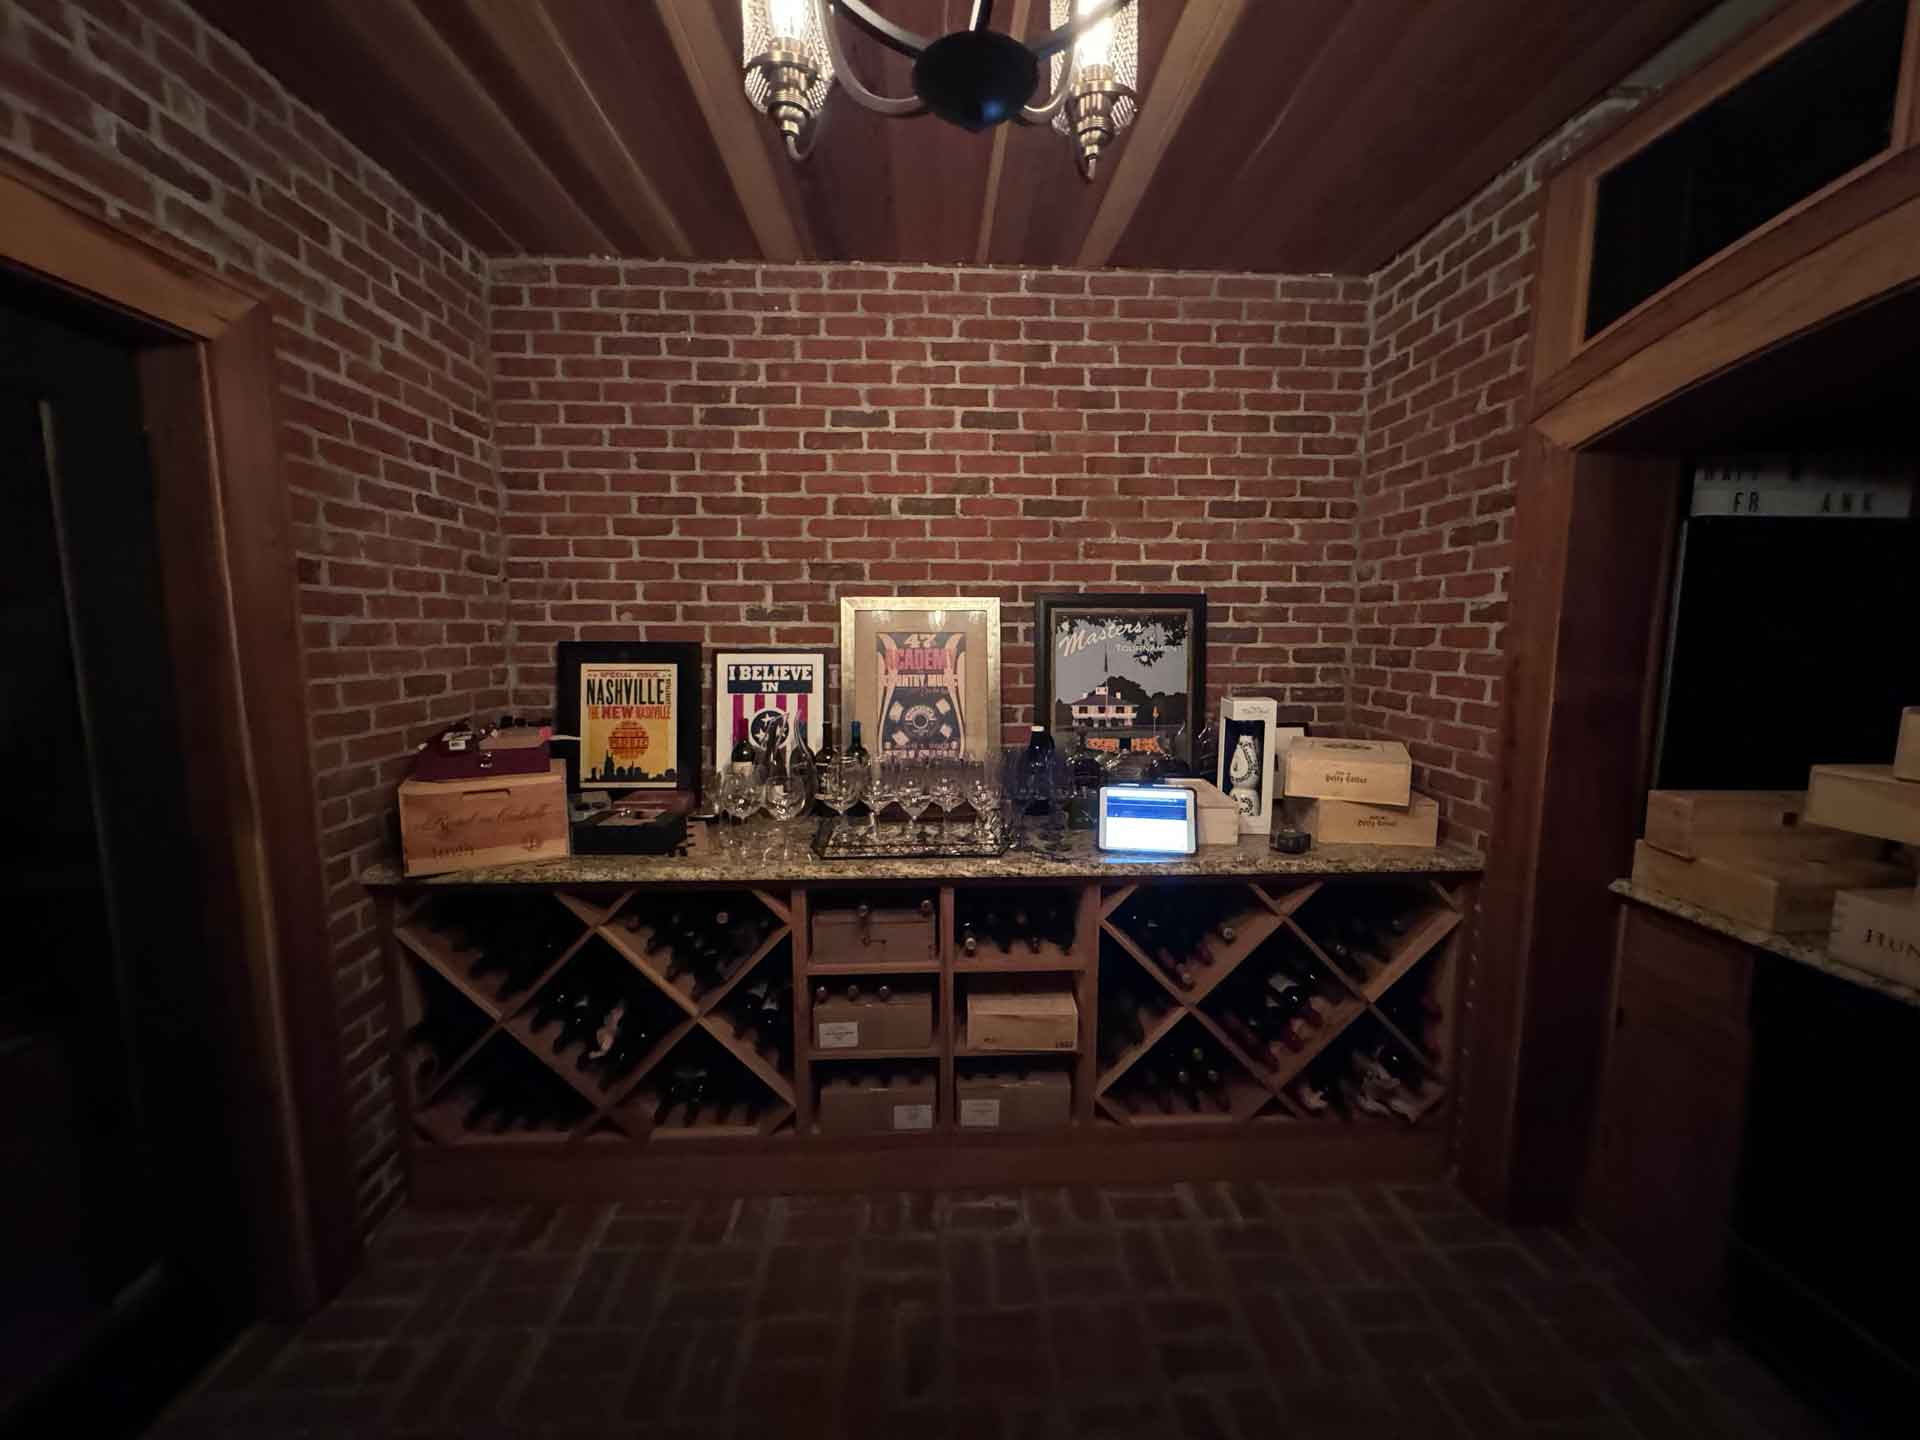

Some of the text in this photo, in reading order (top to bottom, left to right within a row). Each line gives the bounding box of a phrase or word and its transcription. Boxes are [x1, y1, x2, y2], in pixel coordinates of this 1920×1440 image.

[1059, 621, 1144, 657] Masters
[728, 665, 812, 681] I BELIEVE
[587, 678, 665, 704] NASHVILLE
[761, 681, 779, 692] IN
[601, 705, 635, 720] NEW
